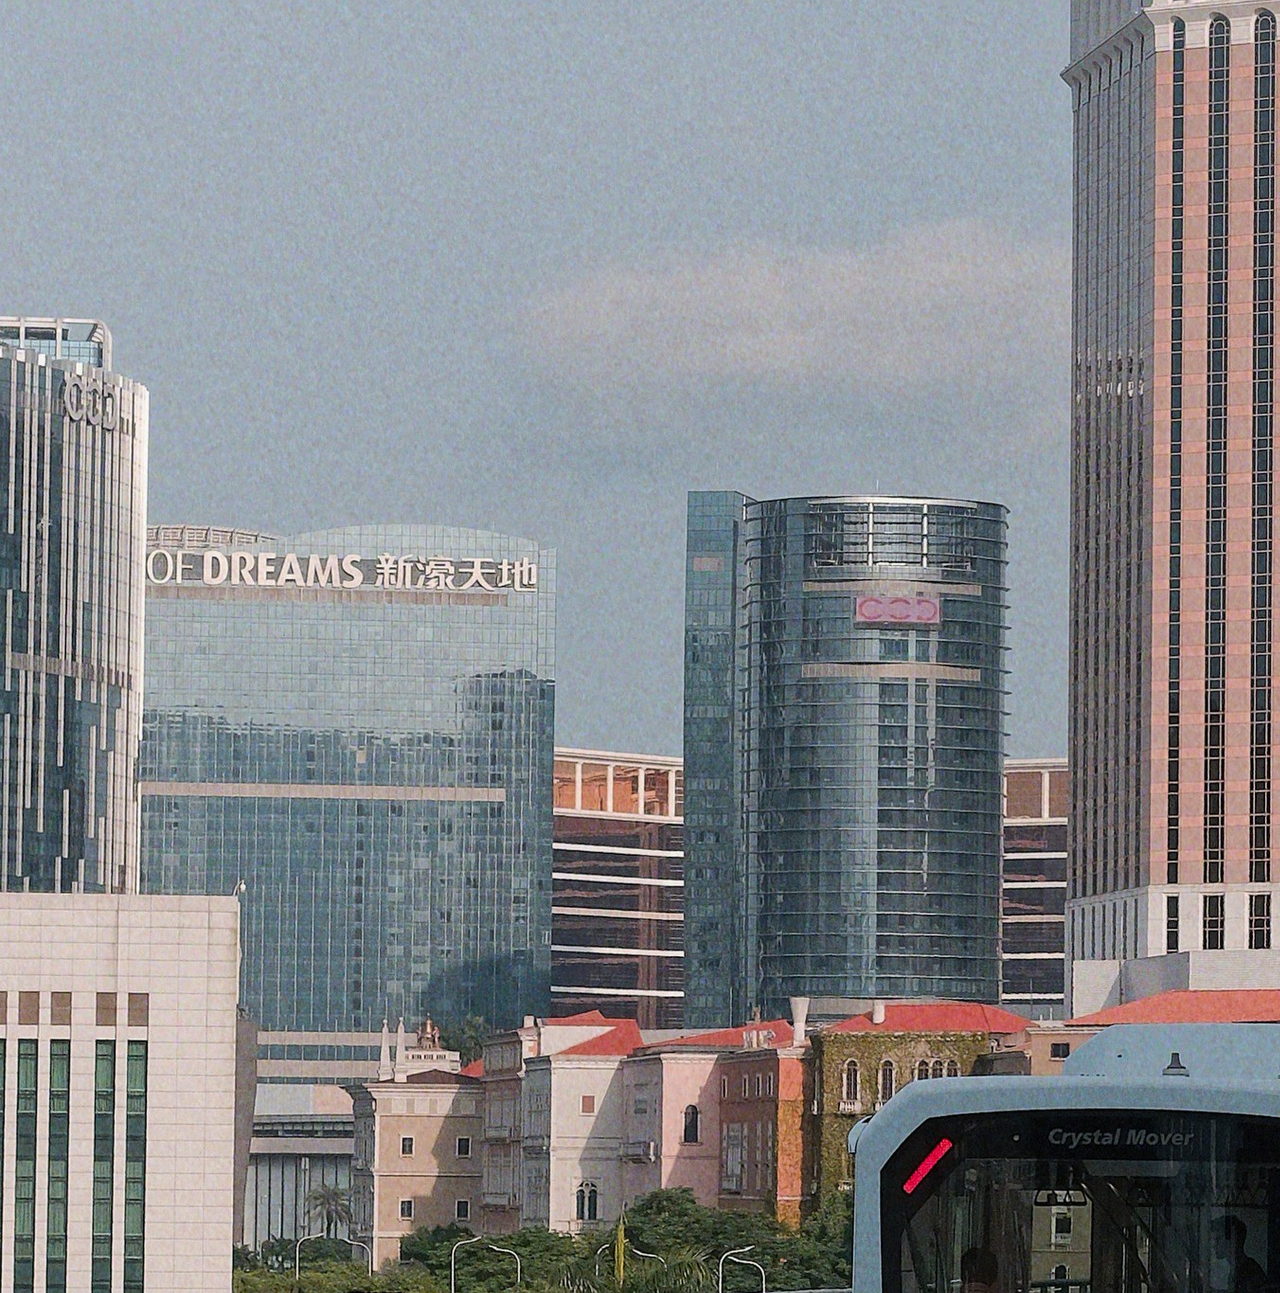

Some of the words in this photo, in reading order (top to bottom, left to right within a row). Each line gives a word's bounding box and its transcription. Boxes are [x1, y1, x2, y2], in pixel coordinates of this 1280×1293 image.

[146, 549, 193, 585] OF
[202, 551, 364, 589] DREAMS
[375, 552, 538, 593] 新濠天地
[1048, 1127, 1121, 1149] Crystal
[1126, 1128, 1195, 1146] Mover
